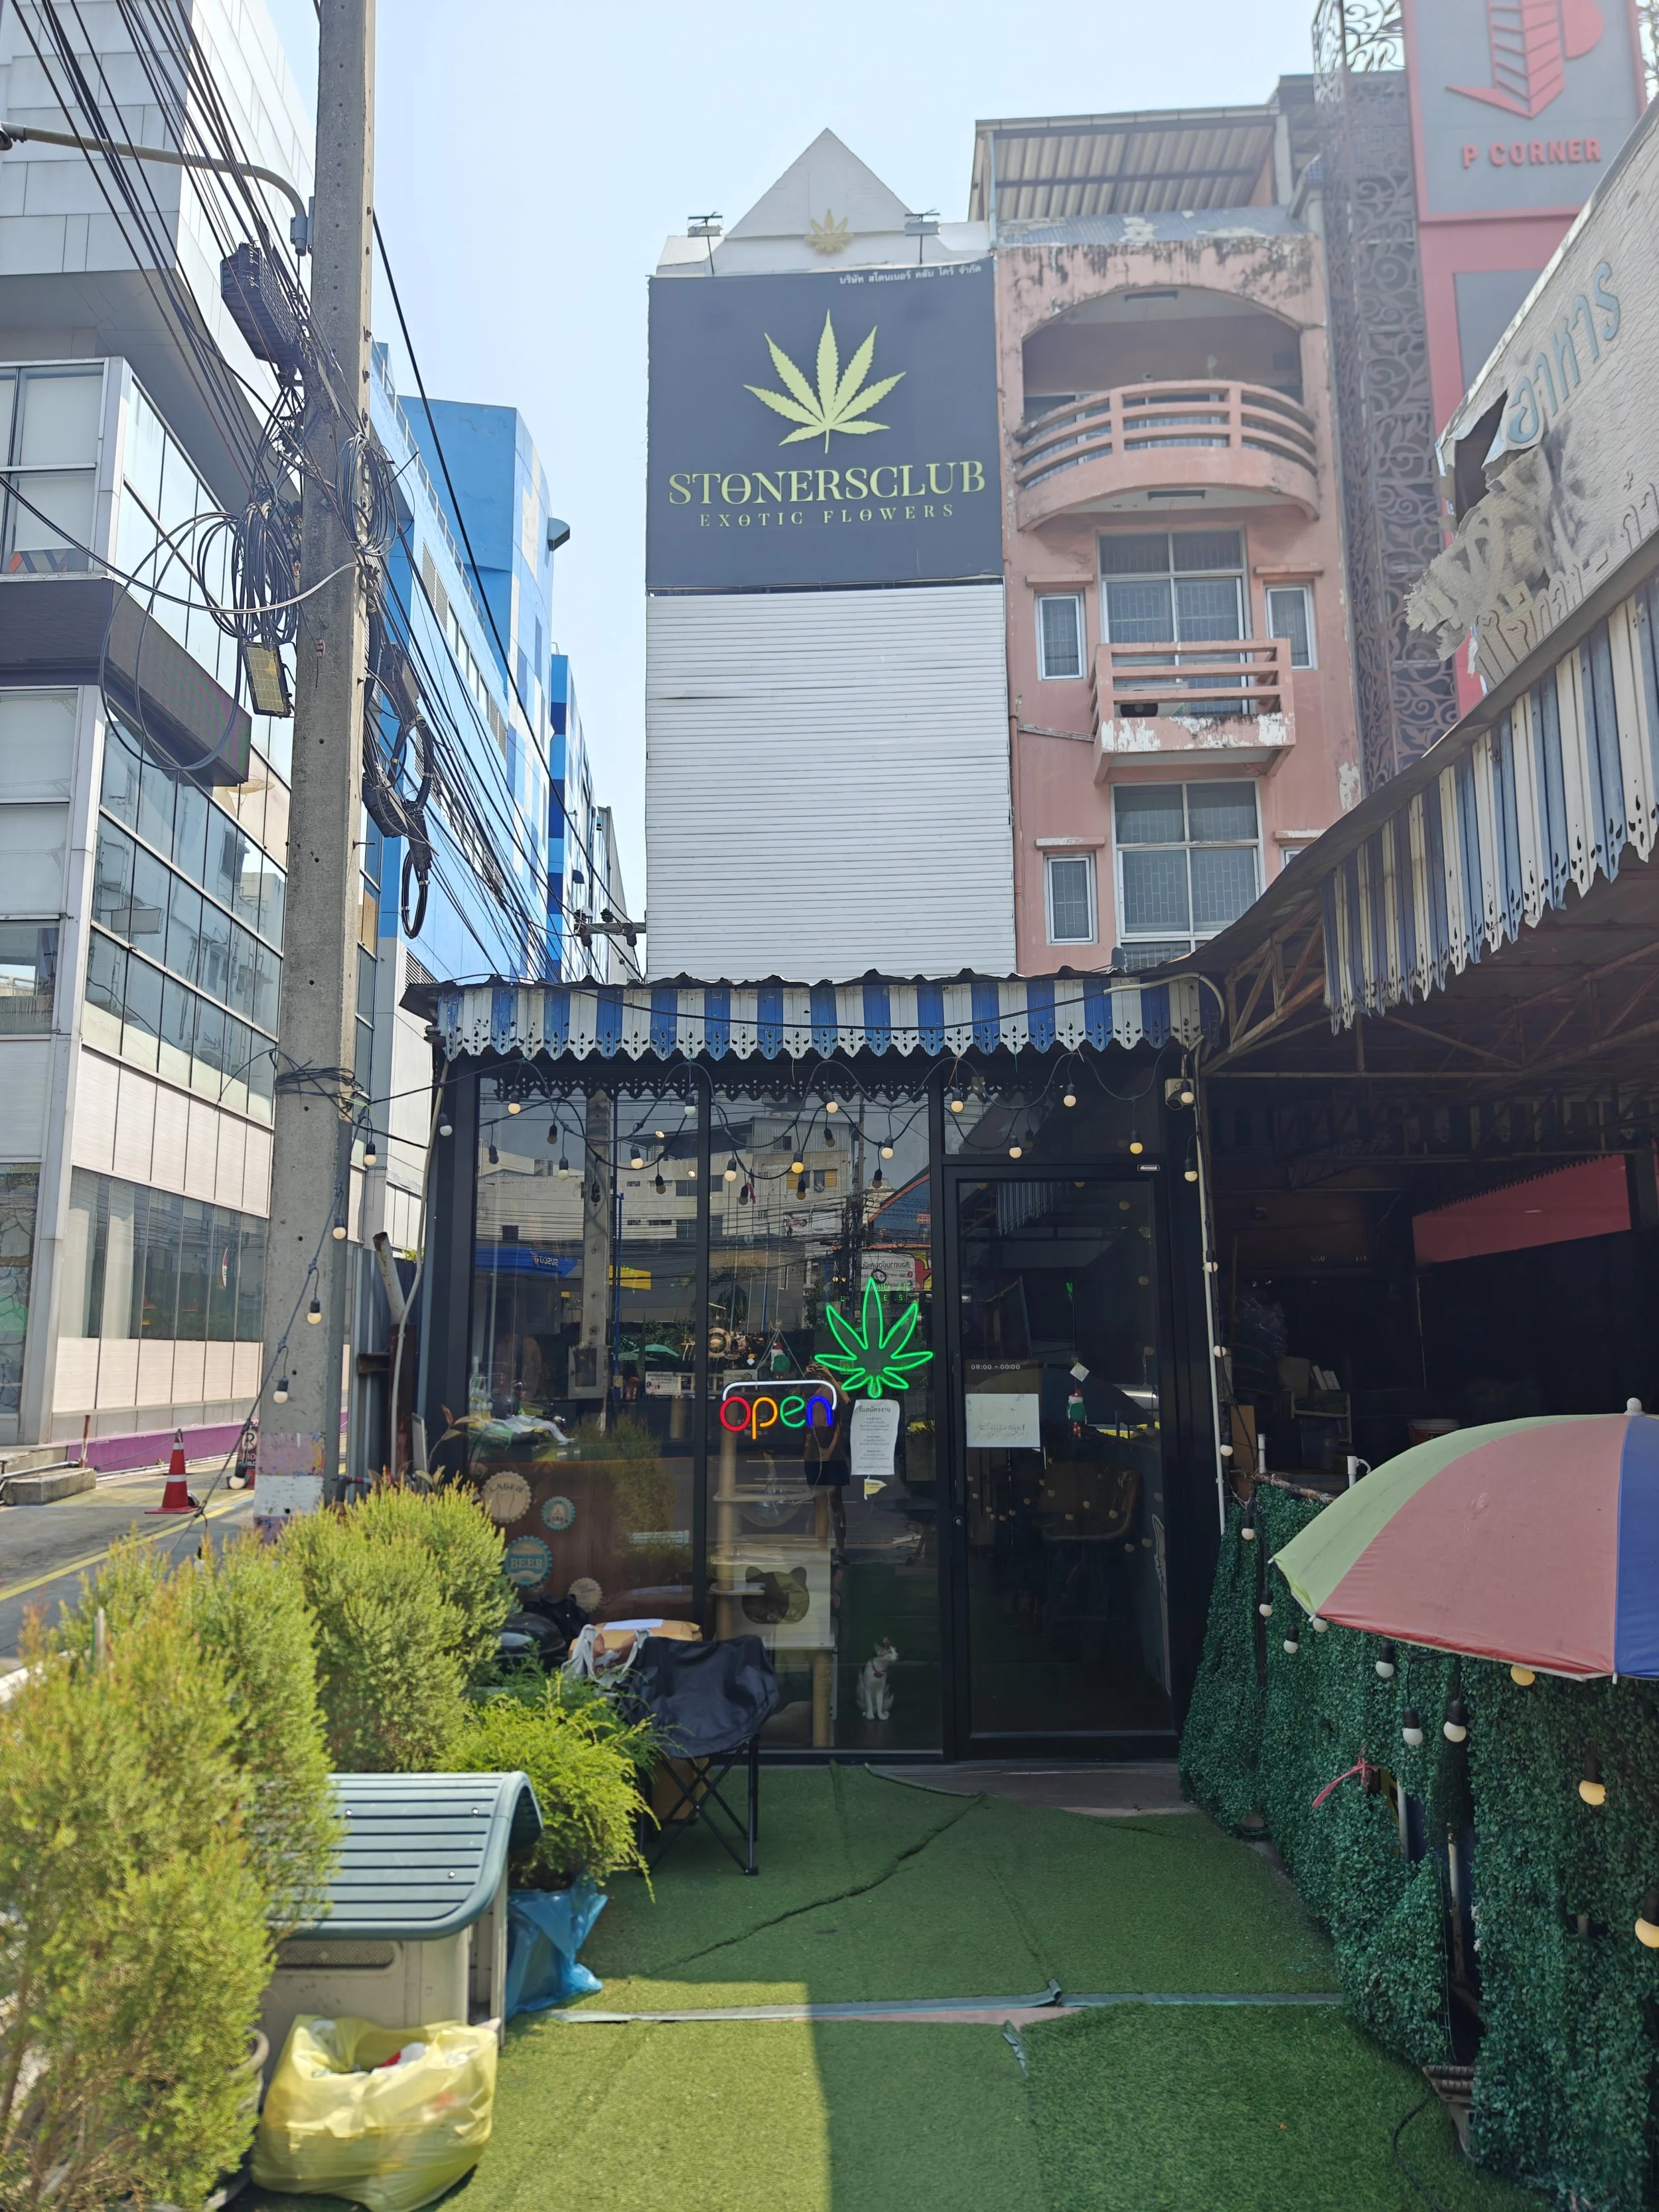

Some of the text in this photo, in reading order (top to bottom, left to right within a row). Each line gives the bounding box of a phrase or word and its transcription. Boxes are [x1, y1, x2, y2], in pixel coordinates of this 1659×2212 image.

[1463, 137, 1601, 169] P CORNER
[1506, 261, 1621, 444] อาหาร
[668, 460, 987, 505] STONERSCLUB
[699, 503, 954, 528] EXOTIC FLOWERS
[720, 1395, 833, 1439] open
[489, 1483, 524, 1493] LAGER
[510, 1558, 544, 1569] BEER
